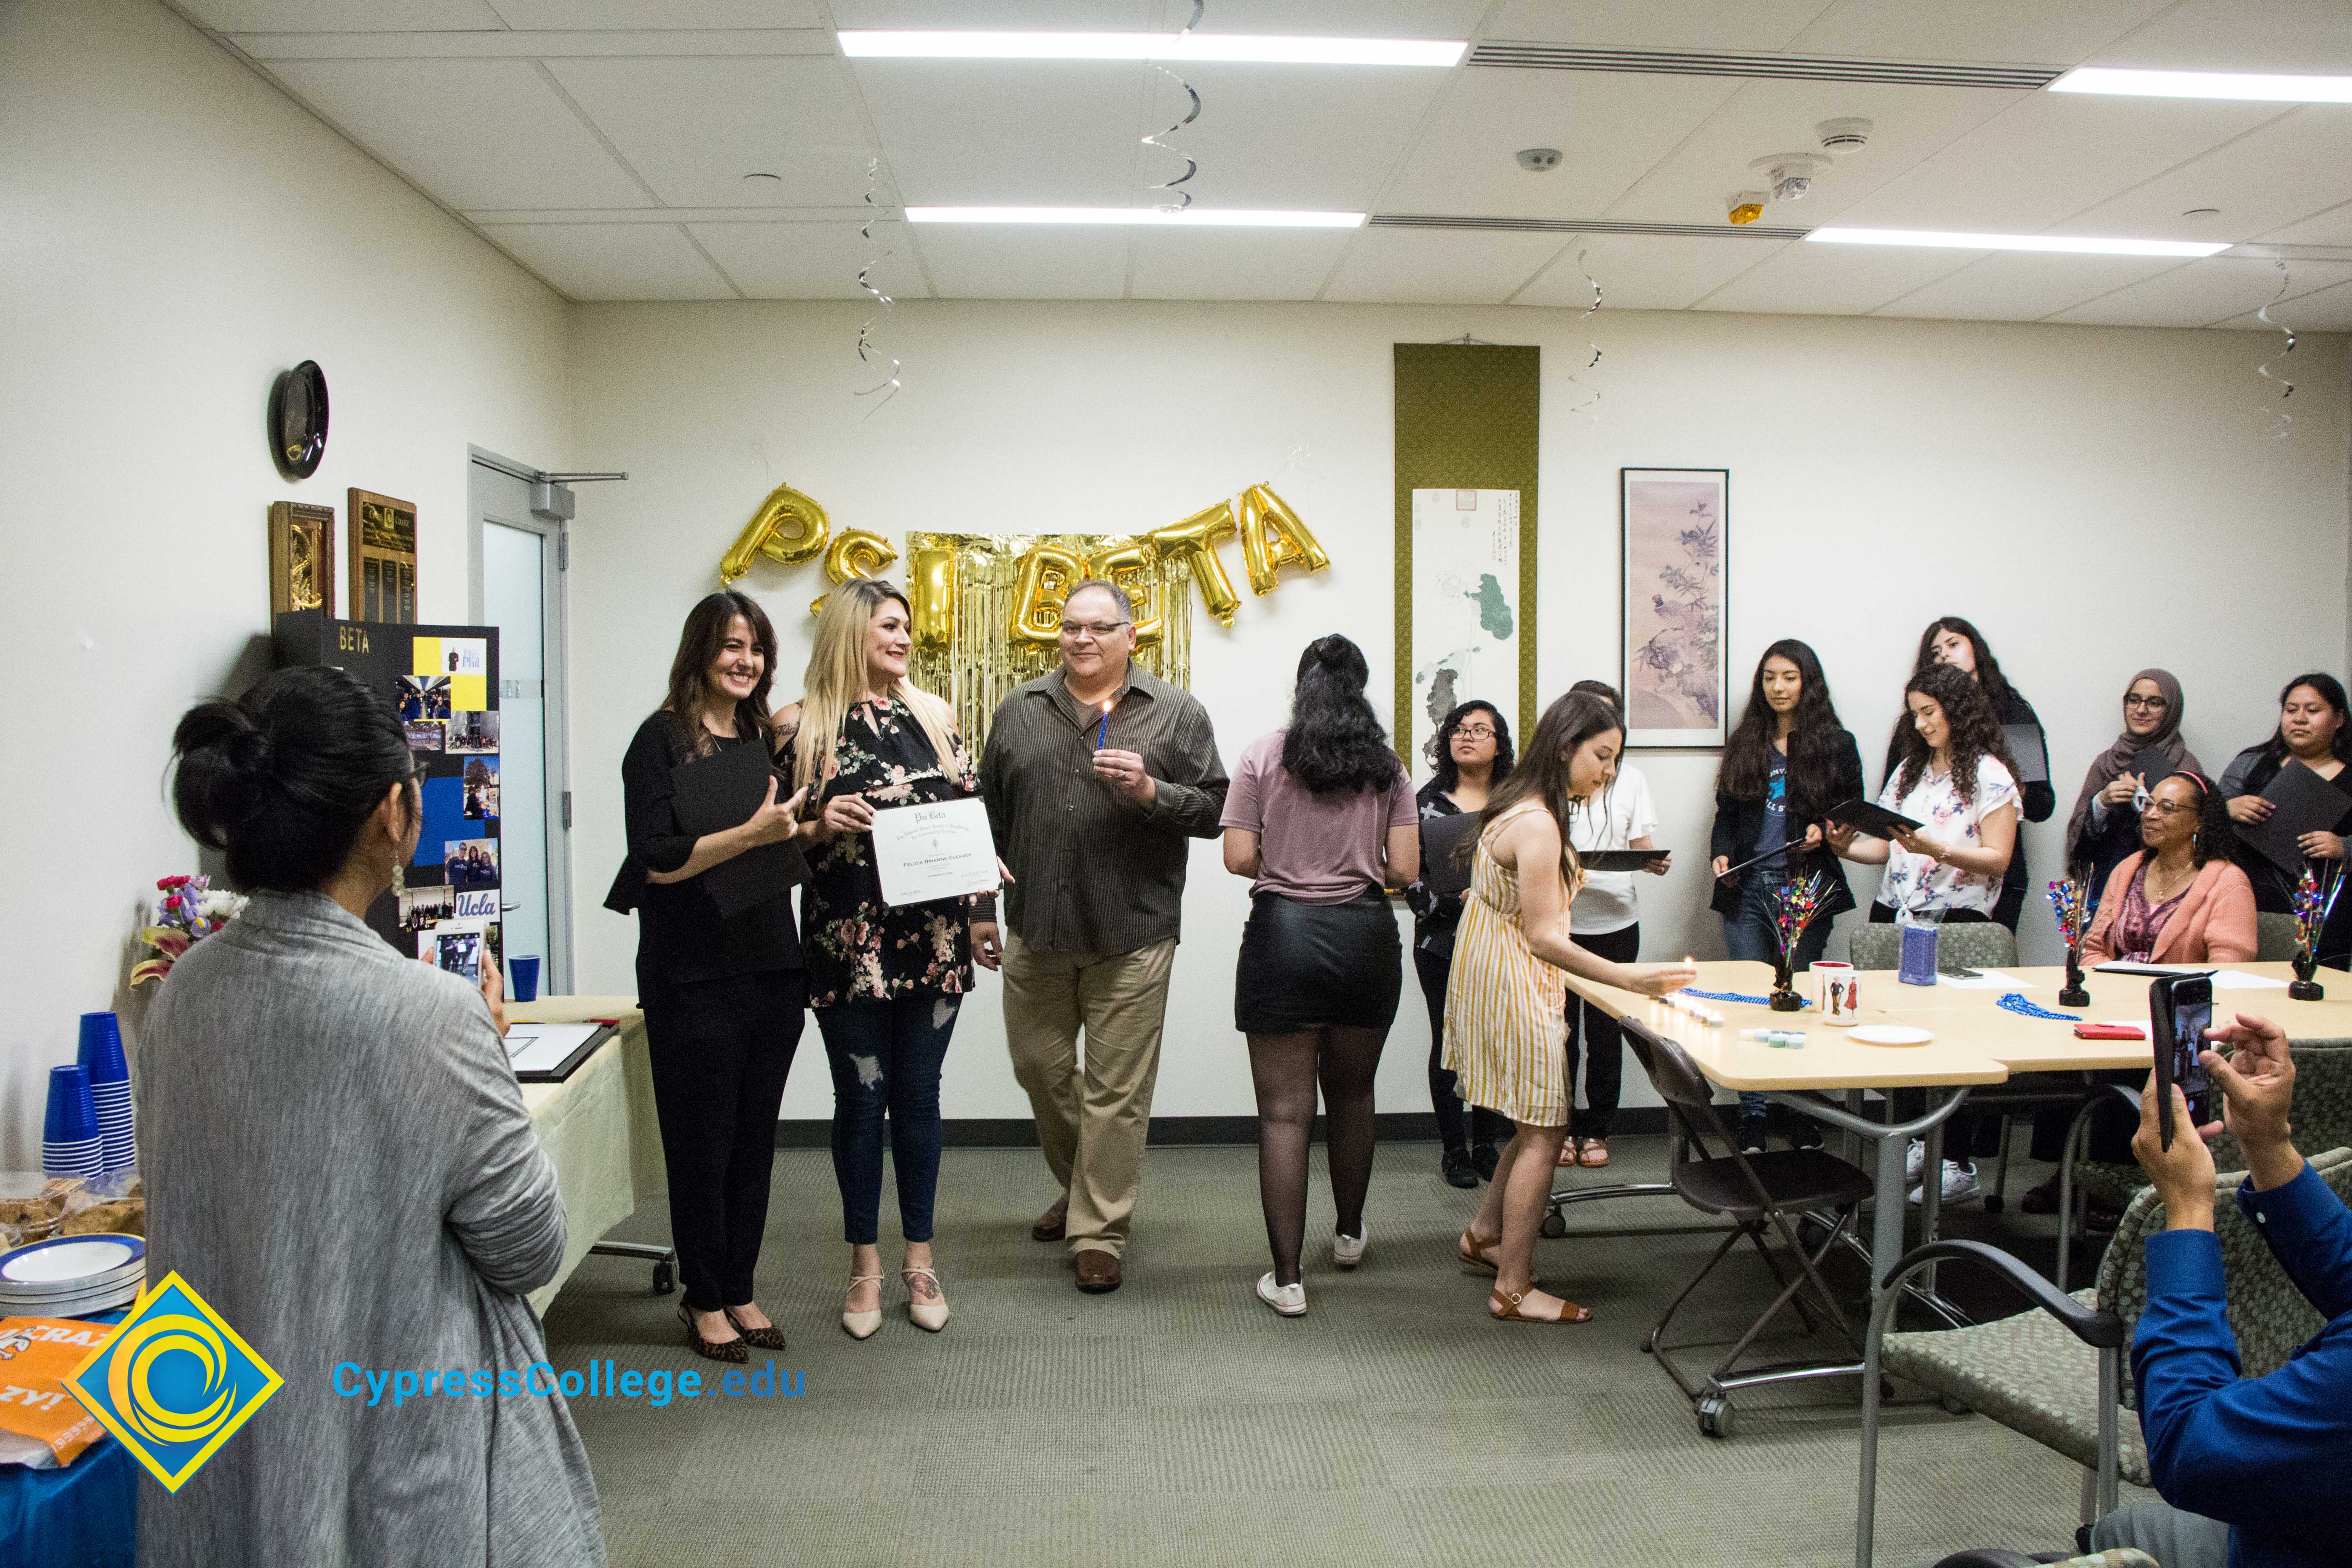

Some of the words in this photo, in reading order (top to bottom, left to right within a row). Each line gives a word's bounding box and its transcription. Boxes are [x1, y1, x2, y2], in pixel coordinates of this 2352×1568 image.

[339, 626, 369, 654] BETA
[462, 656, 479, 668] Phil
[458, 893, 496, 916] Ucla
